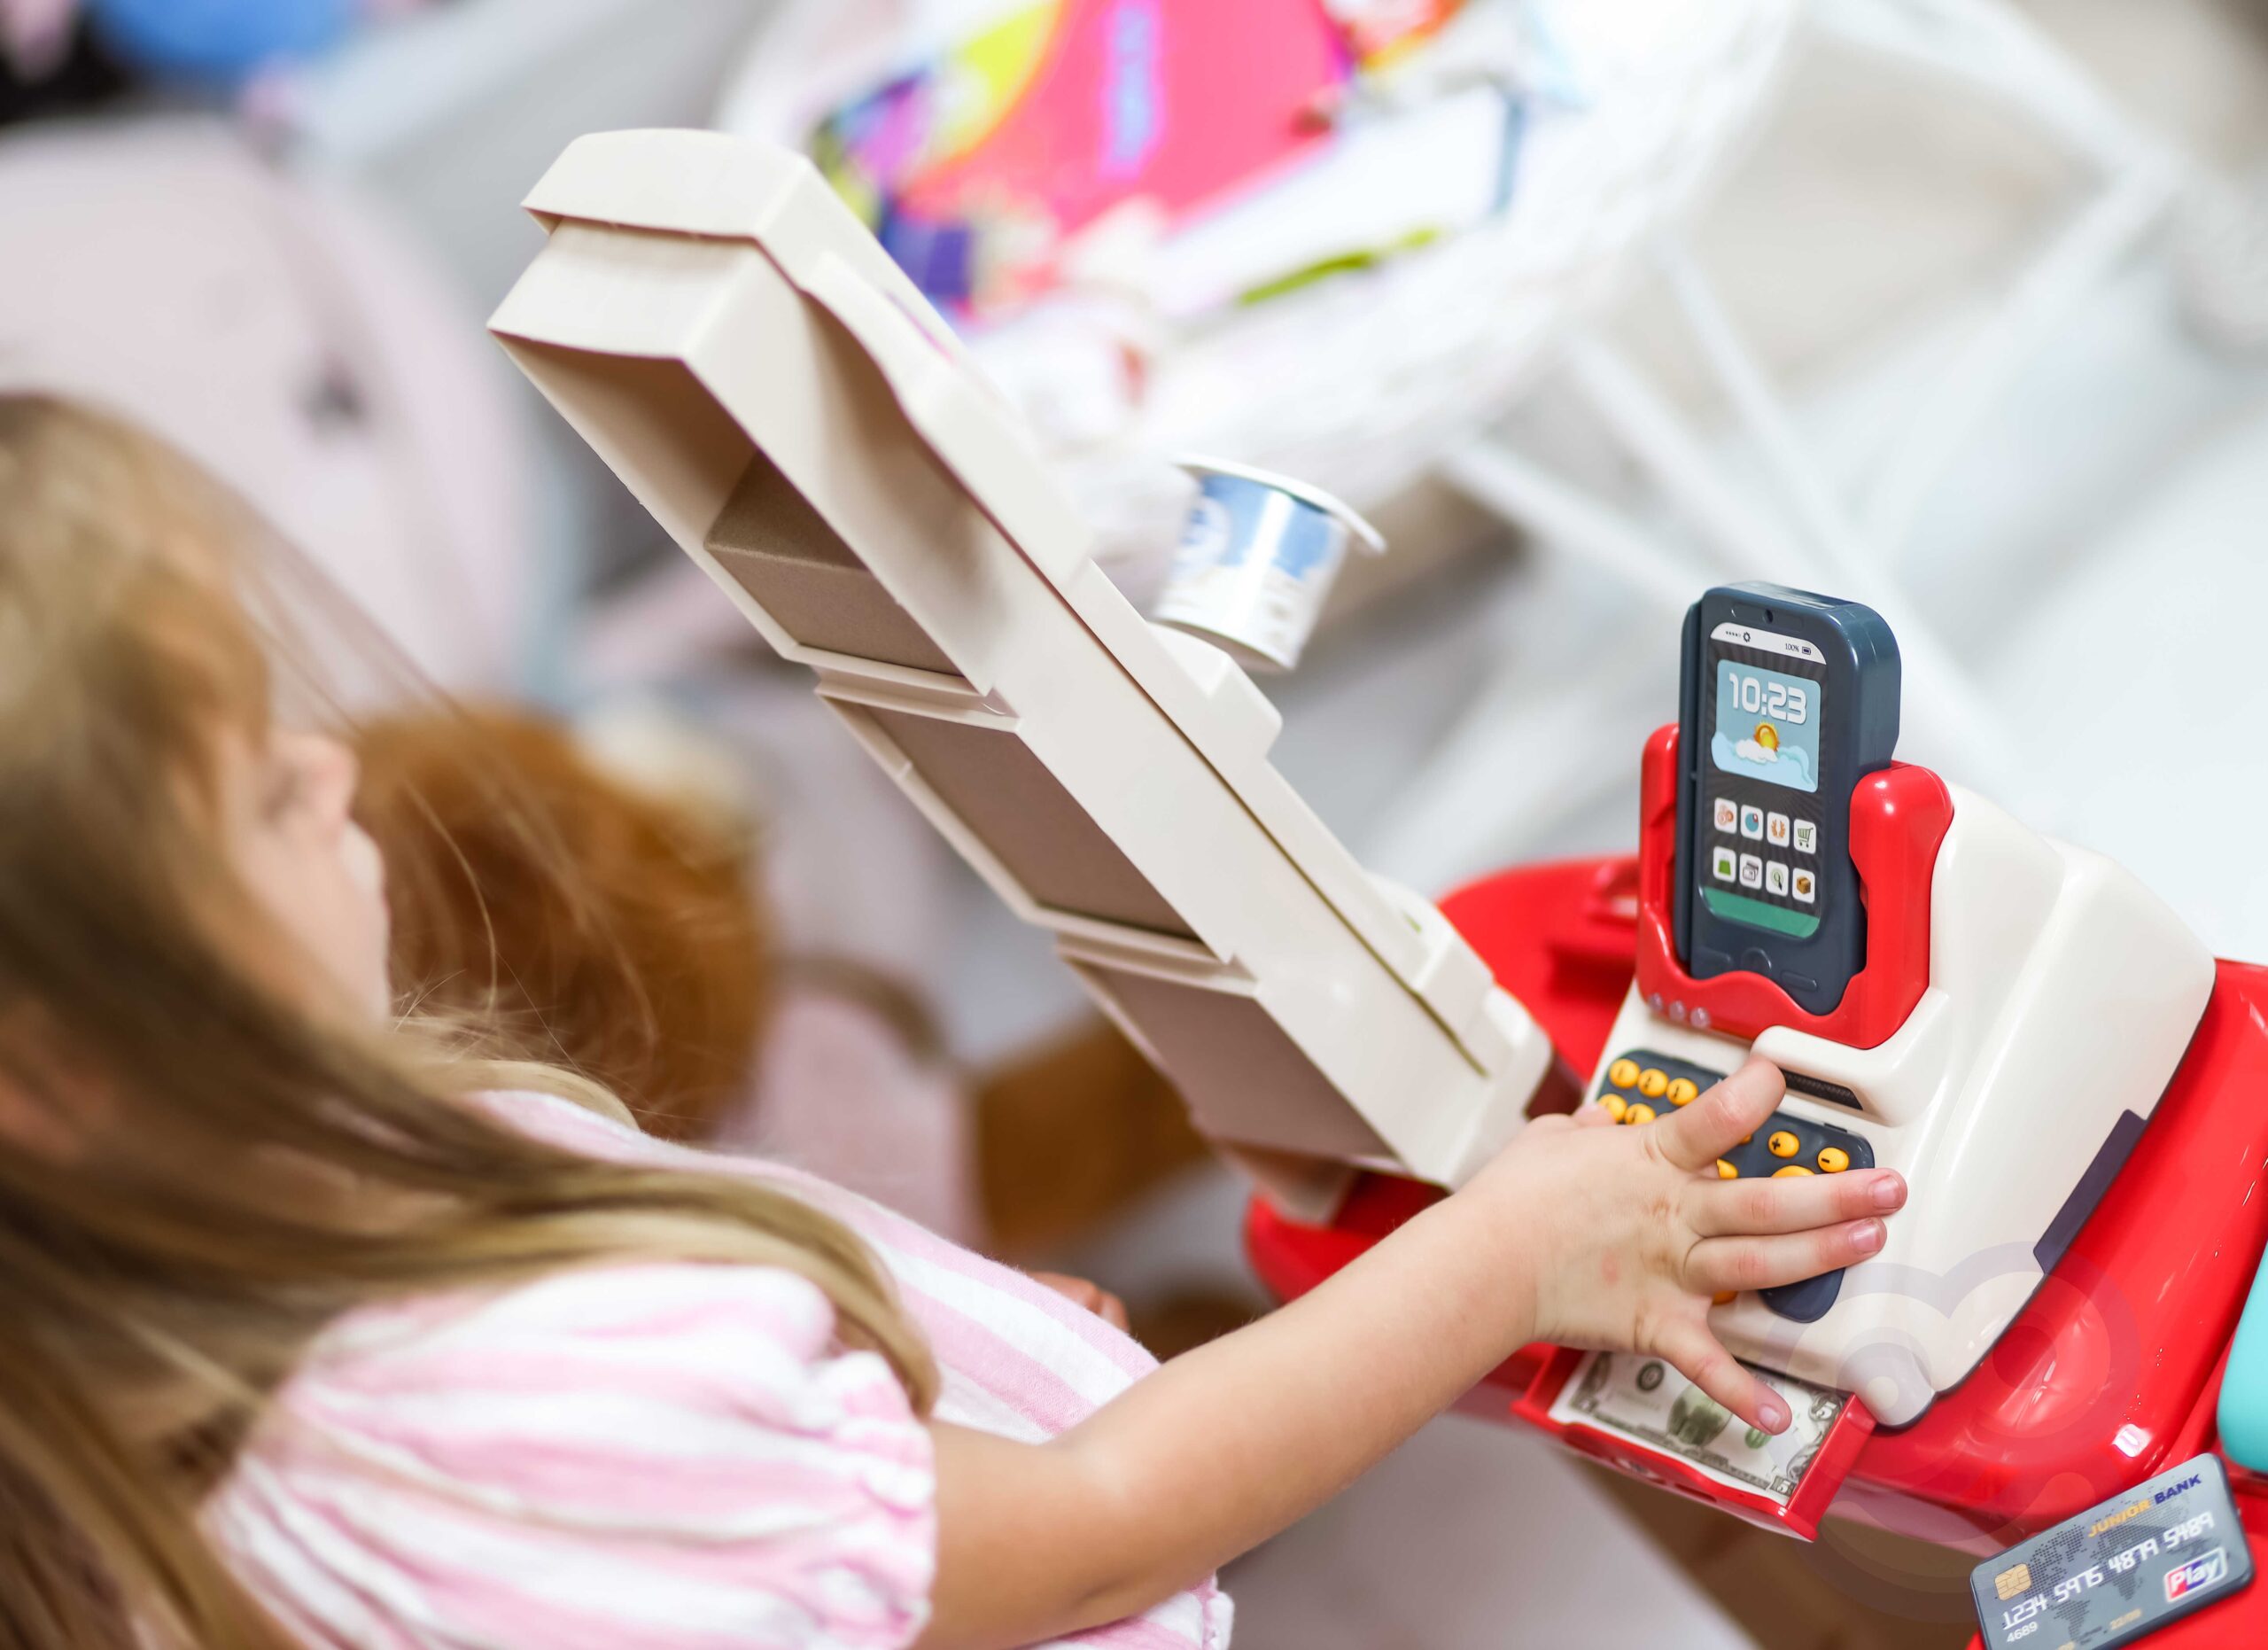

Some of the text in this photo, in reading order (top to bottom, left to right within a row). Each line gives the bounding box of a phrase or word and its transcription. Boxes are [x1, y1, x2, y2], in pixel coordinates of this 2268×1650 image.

[1785, 642, 1799, 653] 100%
[1728, 672, 1807, 725] 10:23
[2087, 1474, 2202, 1538] JUNIOR BANK
[2001, 1594, 2048, 1631] 1234
[2163, 1510, 2216, 1549] 5489
[2170, 1557, 2223, 1594] Play
[2006, 1621, 2039, 1643] 4689
